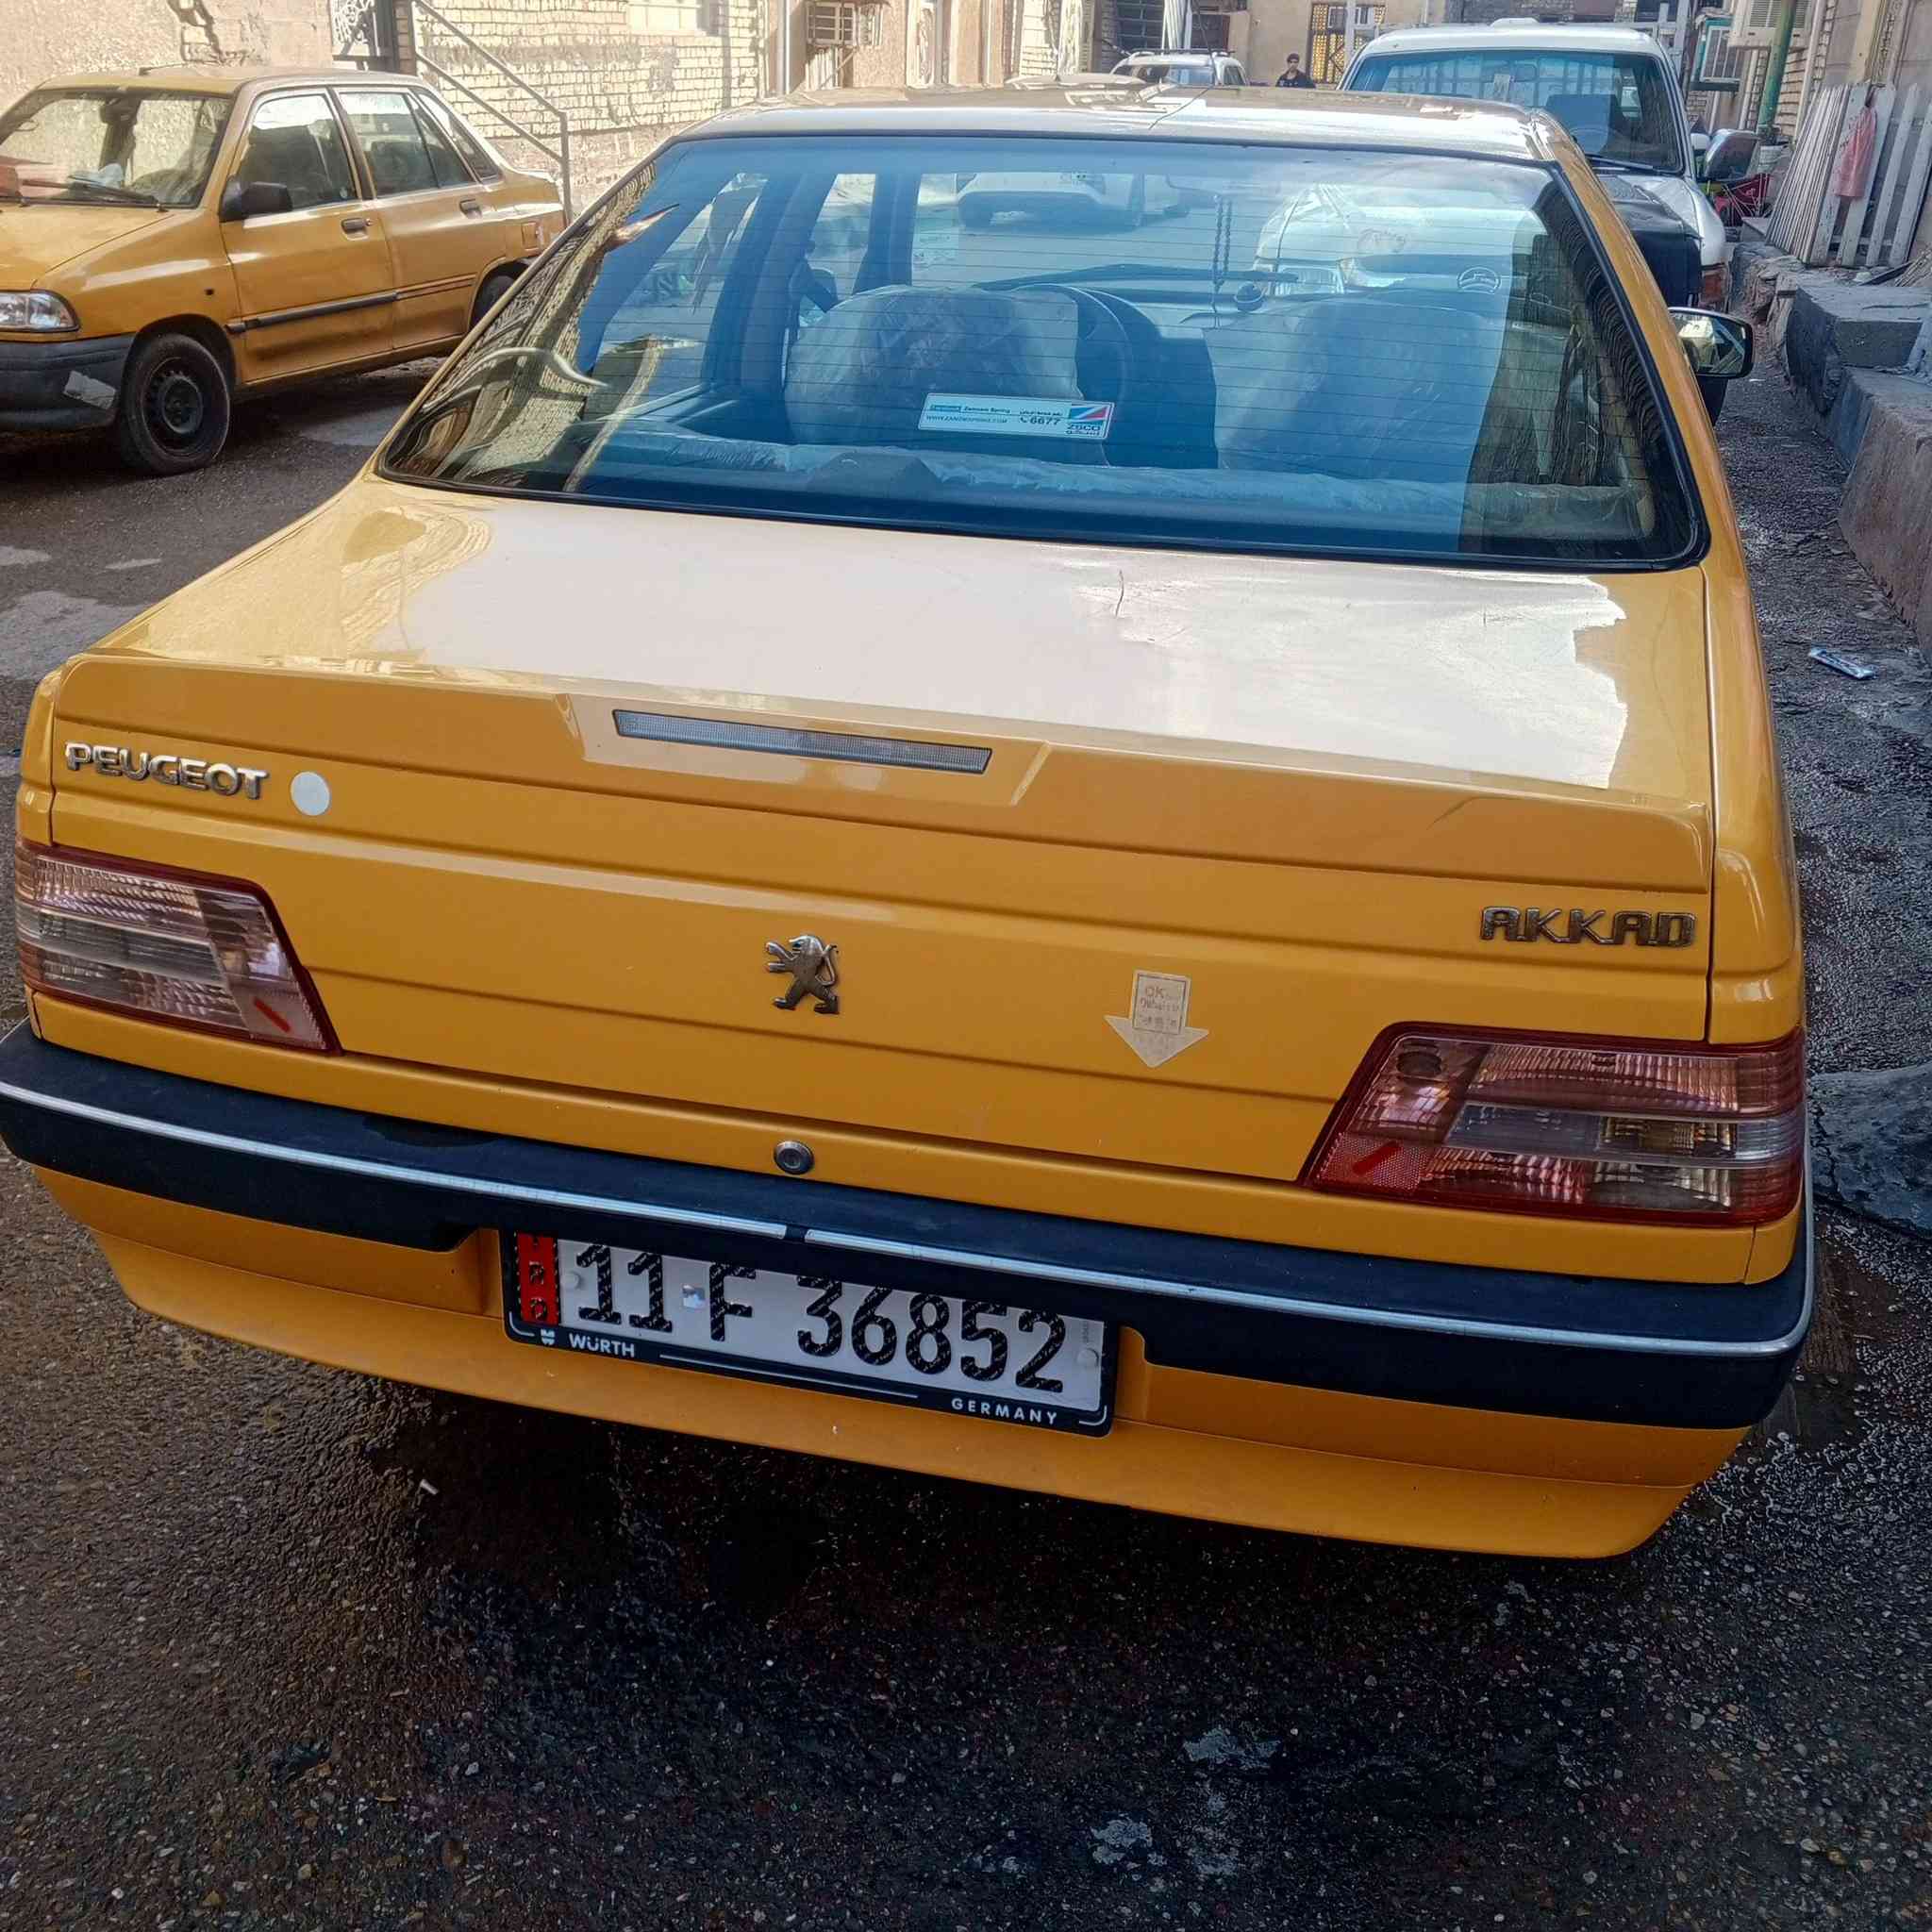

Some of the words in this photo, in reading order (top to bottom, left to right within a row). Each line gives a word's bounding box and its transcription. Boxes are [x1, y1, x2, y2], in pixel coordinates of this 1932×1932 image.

[65, 742, 268, 799] PEUGEOT
[1481, 907, 1696, 947] AKKAD
[576, 1244, 673, 1333] 11
[709, 1262, 756, 1342] F
[796, 1275, 1064, 1392] 36852
[569, 1333, 635, 1357] WÜRTH
[951, 1398, 1058, 1424] GERMANY
